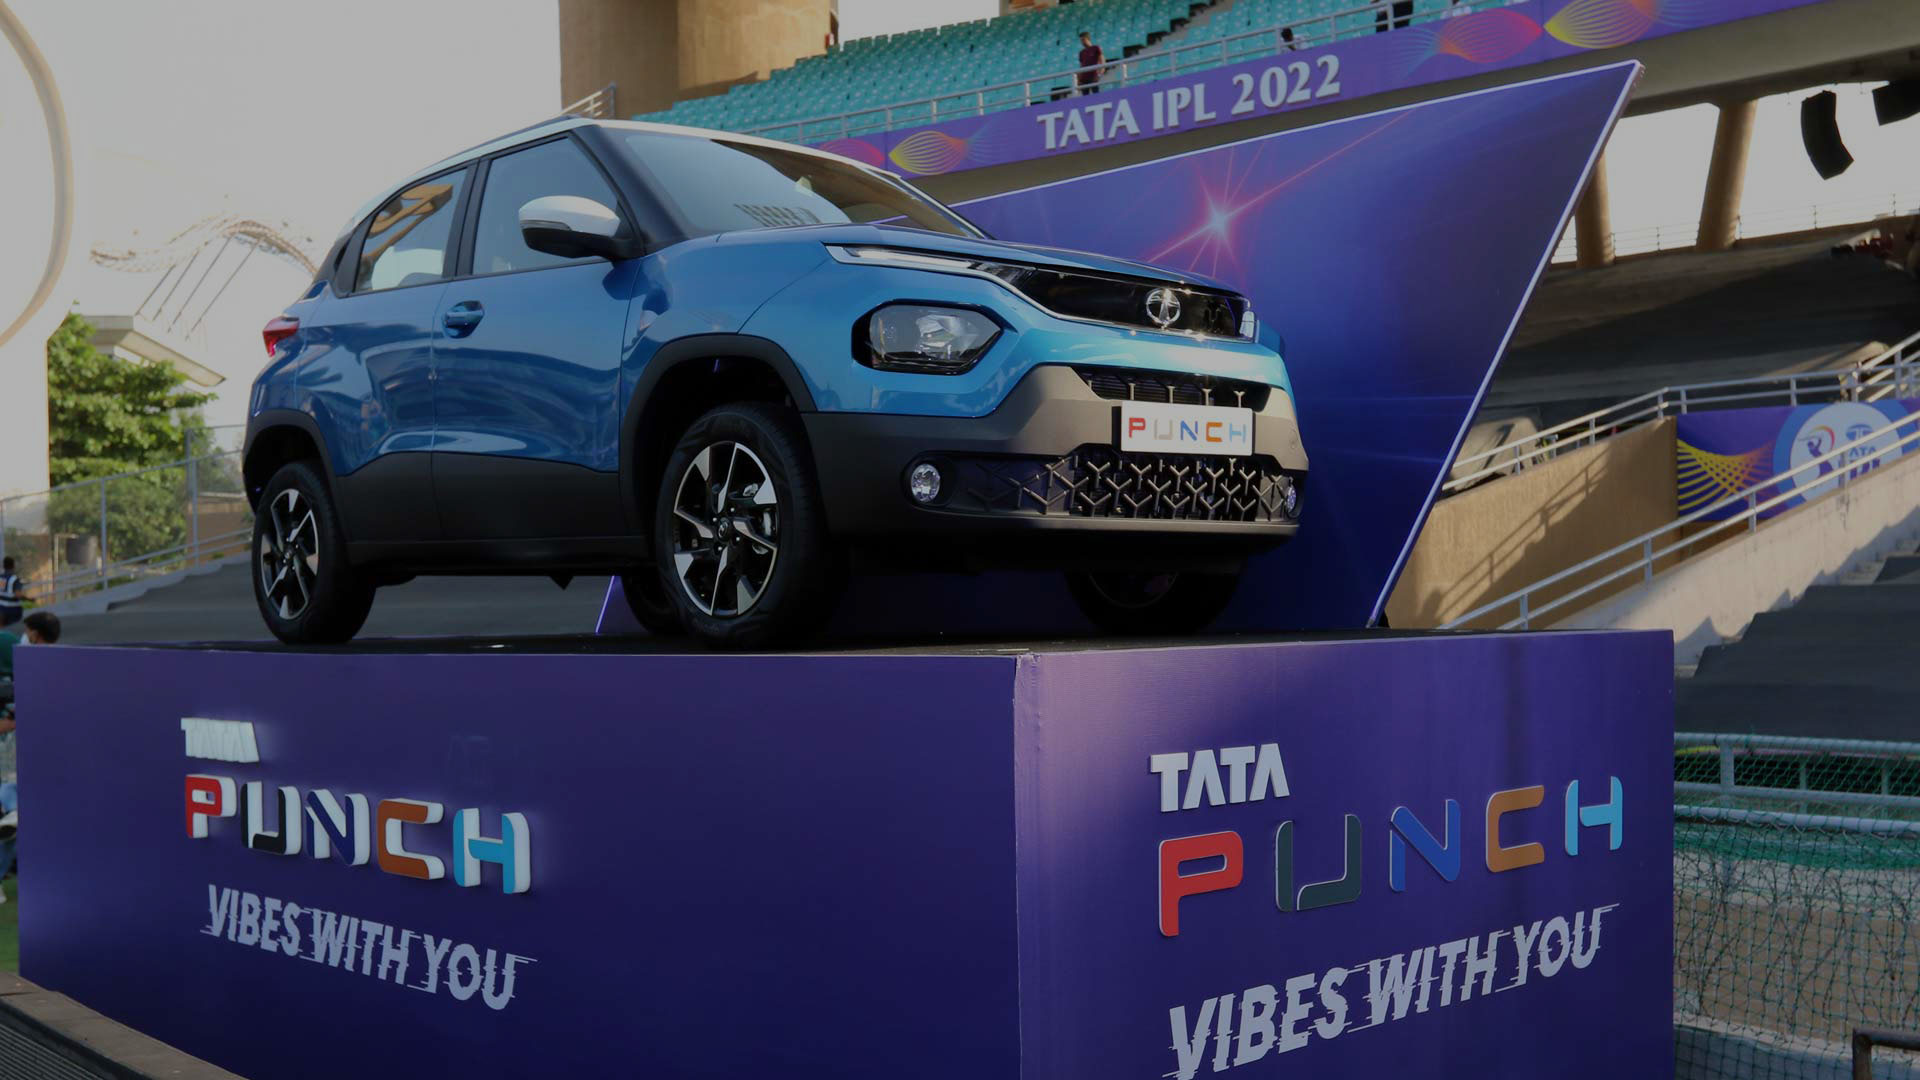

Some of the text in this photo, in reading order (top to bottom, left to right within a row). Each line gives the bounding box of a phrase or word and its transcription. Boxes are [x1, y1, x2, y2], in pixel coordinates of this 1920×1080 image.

[1037, 54, 1341, 149] TATA IPL 2022
[1128, 417, 1247, 443] PUNCH
[185, 774, 531, 894] PUNCH
[1149, 743, 1290, 812] TATA
[1158, 776, 1623, 937] PUNCH
[201, 884, 536, 1010] VIBES WITH YOU
[1163, 904, 1619, 1080] VIBES WITH YOU
